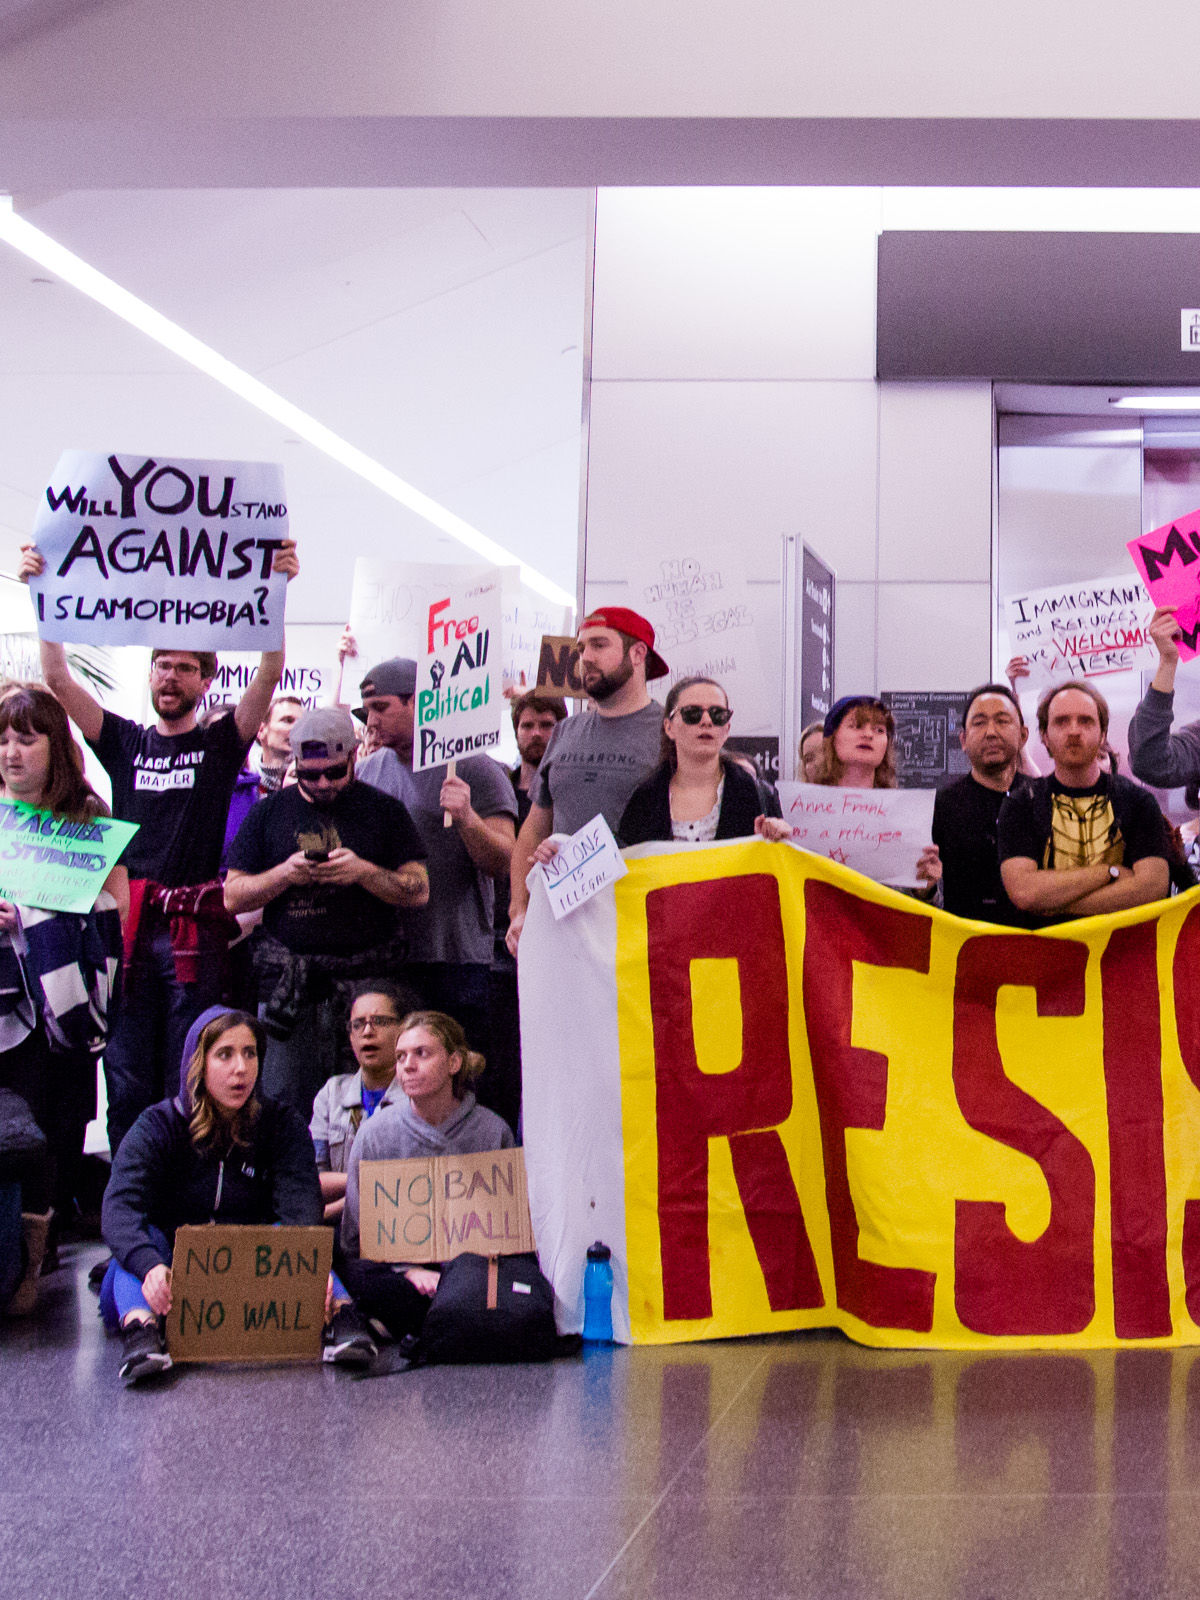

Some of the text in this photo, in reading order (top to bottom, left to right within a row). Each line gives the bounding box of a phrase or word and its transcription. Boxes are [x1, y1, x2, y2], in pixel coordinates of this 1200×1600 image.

[108, 454, 236, 518] YOU
[230, 502, 287, 519] STAND
[56, 525, 285, 579] AGAINST
[427, 597, 479, 655] Free
[1052, 627, 1153, 657] WELCOME
[451, 629, 489, 677] All
[1068, 651, 1133, 676] HERE
[418, 673, 490, 727] Political
[790, 796, 836, 814] Anne
[542, 828, 600, 881] NO ONE
[573, 867, 584, 882] IS
[560, 871, 613, 912] ILLEGAL
[374, 1162, 514, 1208] NO BAN
[378, 1212, 520, 1246] NO WALL
[186, 1245, 318, 1278] NO BAN
[179, 1300, 311, 1337] NO WALL
